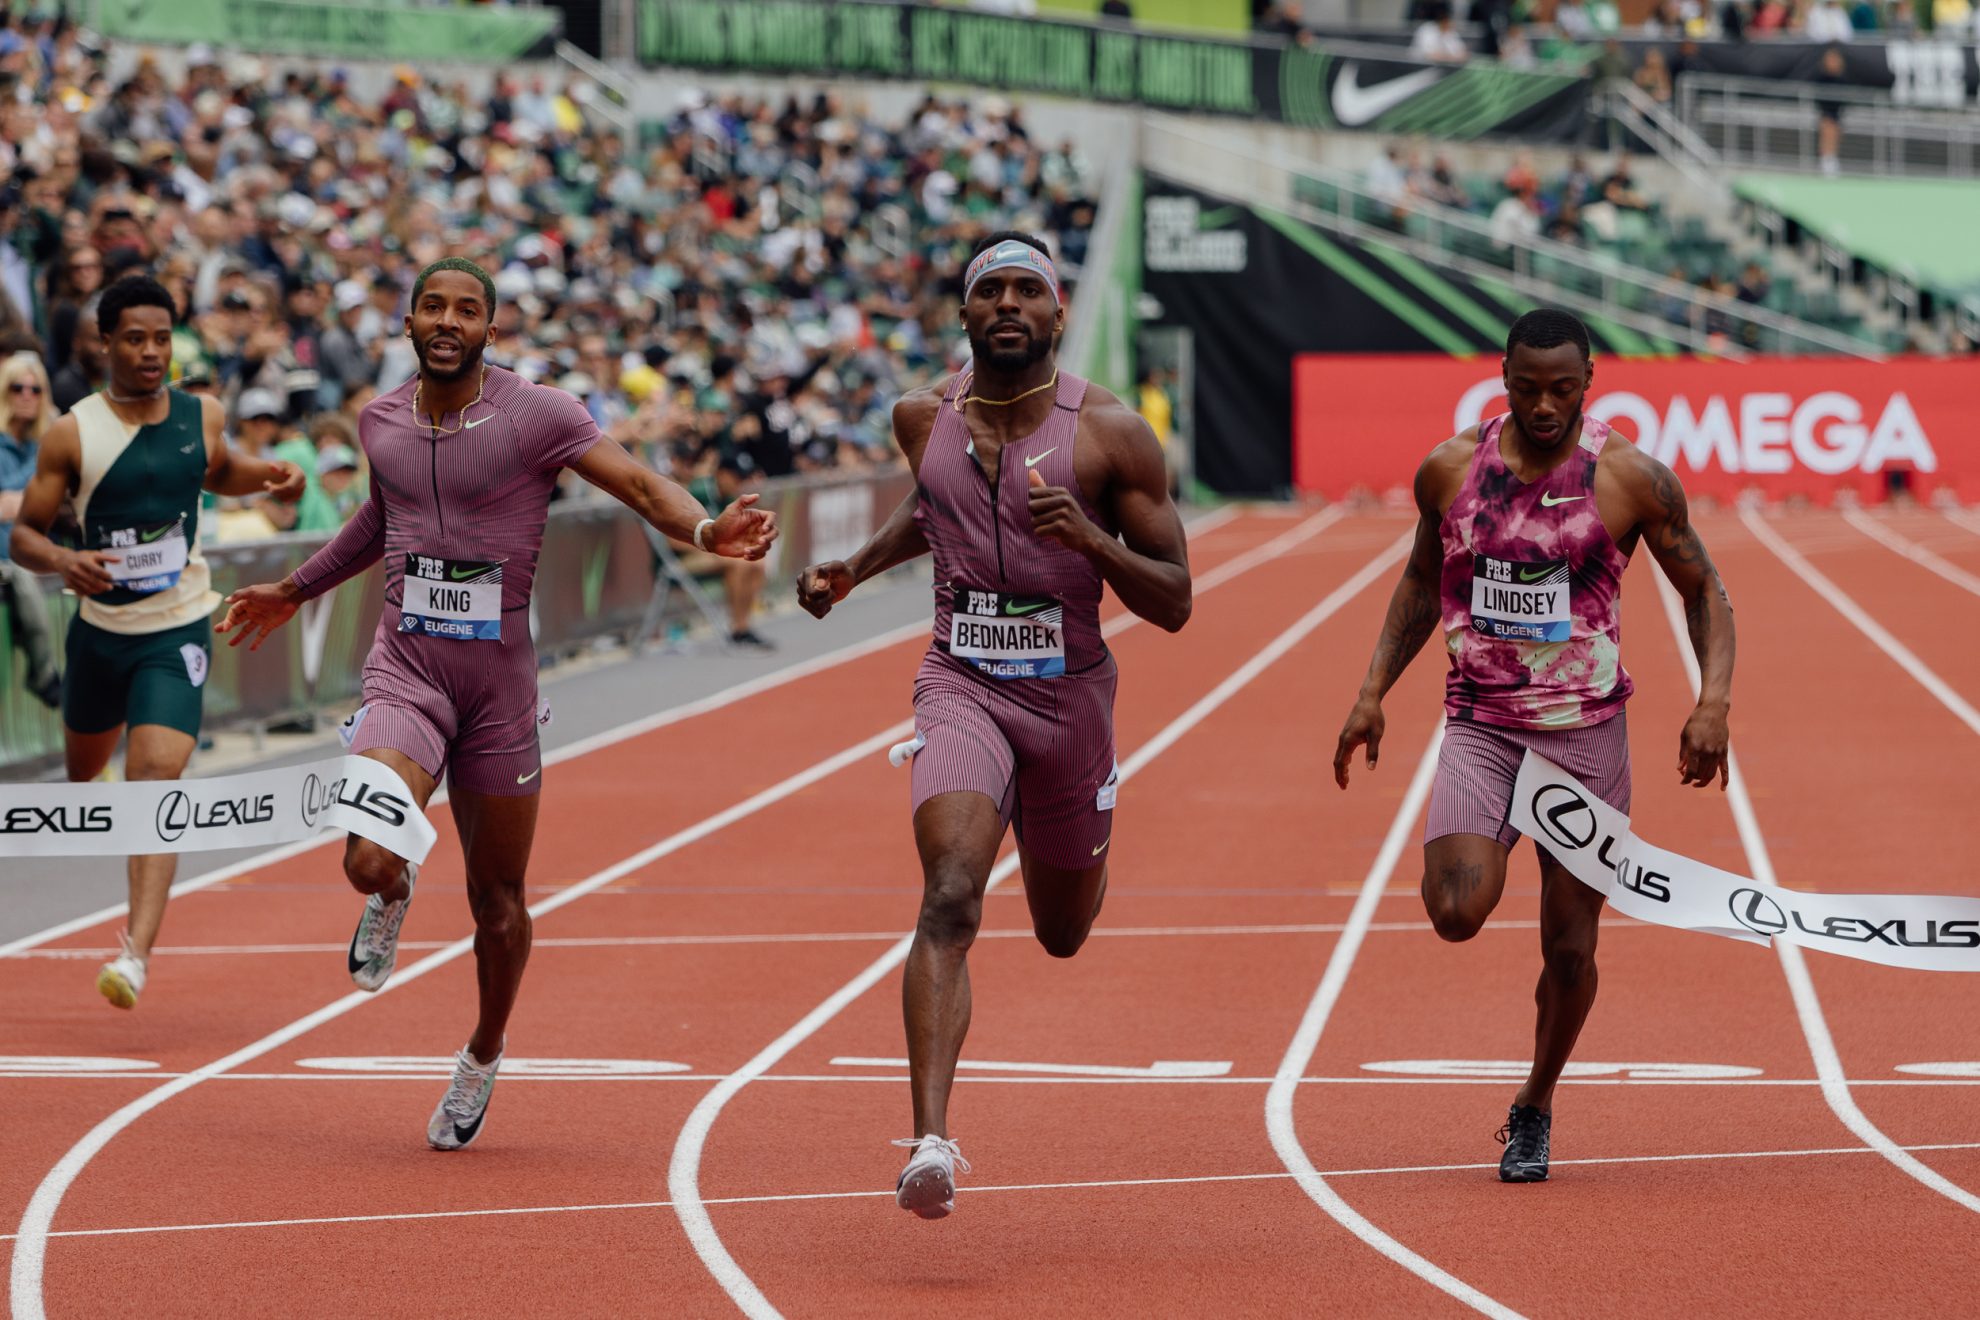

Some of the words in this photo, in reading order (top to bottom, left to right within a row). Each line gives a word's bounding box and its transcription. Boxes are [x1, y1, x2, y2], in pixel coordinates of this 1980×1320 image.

[1589, 390, 1938, 475] OMEGA
[111, 528, 138, 547] PRE
[126, 551, 163, 570] CURRY
[417, 556, 444, 580] PRE
[1485, 557, 1512, 582] PRE
[127, 575, 171, 591] EUGENE
[429, 587, 471, 613] KING
[967, 590, 998, 616] PRE
[1483, 586, 1557, 615] LINDSEY
[424, 620, 474, 635] EUGENE
[956, 622, 1058, 650] BEDNAREK
[1494, 623, 1544, 638] EUGENE
[978, 662, 1035, 675] EUGENE
[0, 806, 112, 833] EXUS
[194, 794, 274, 829] LEXUS
[1791, 910, 1980, 948] LEXUS
